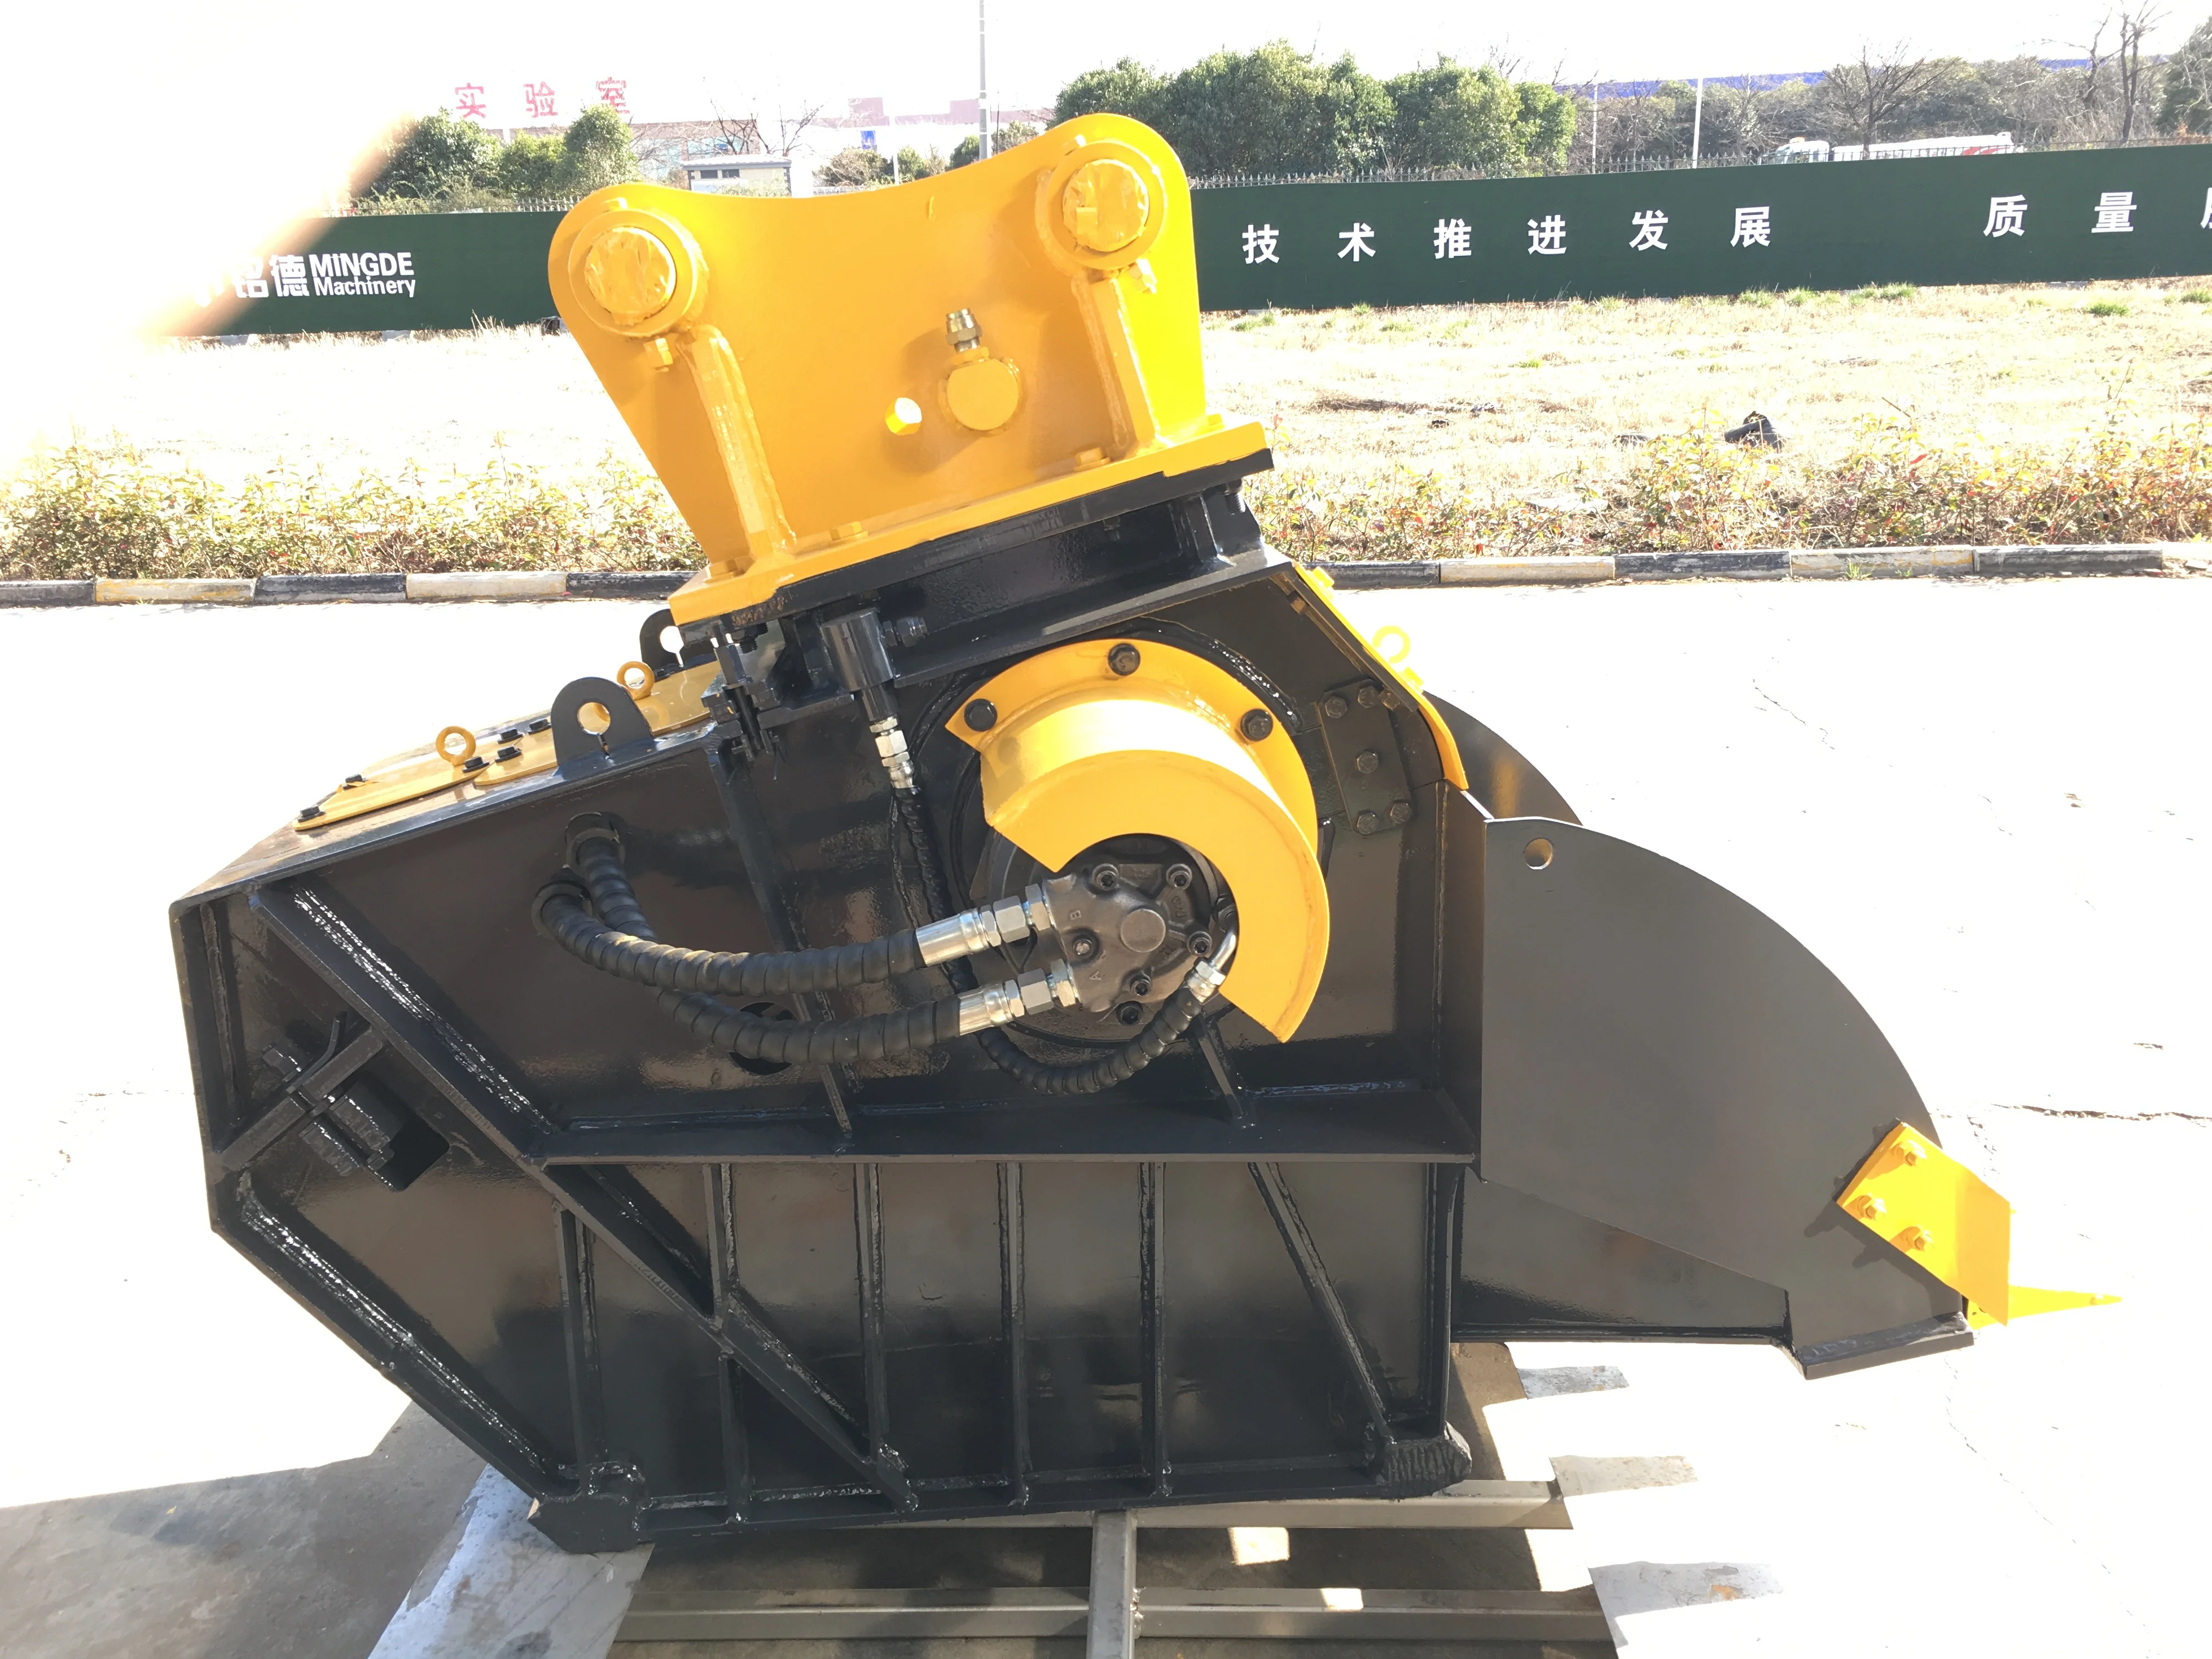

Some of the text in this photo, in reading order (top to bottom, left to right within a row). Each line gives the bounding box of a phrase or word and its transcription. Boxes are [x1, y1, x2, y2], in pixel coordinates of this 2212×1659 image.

[455, 76, 630, 119] 实验室
[1242, 187, 2212, 264] 技术推进发展 质量
[309, 252, 414, 276] MINGDE
[313, 275, 416, 298] Machinery
[1070, 910, 1082, 921] B
[1089, 971, 1102, 981] A
